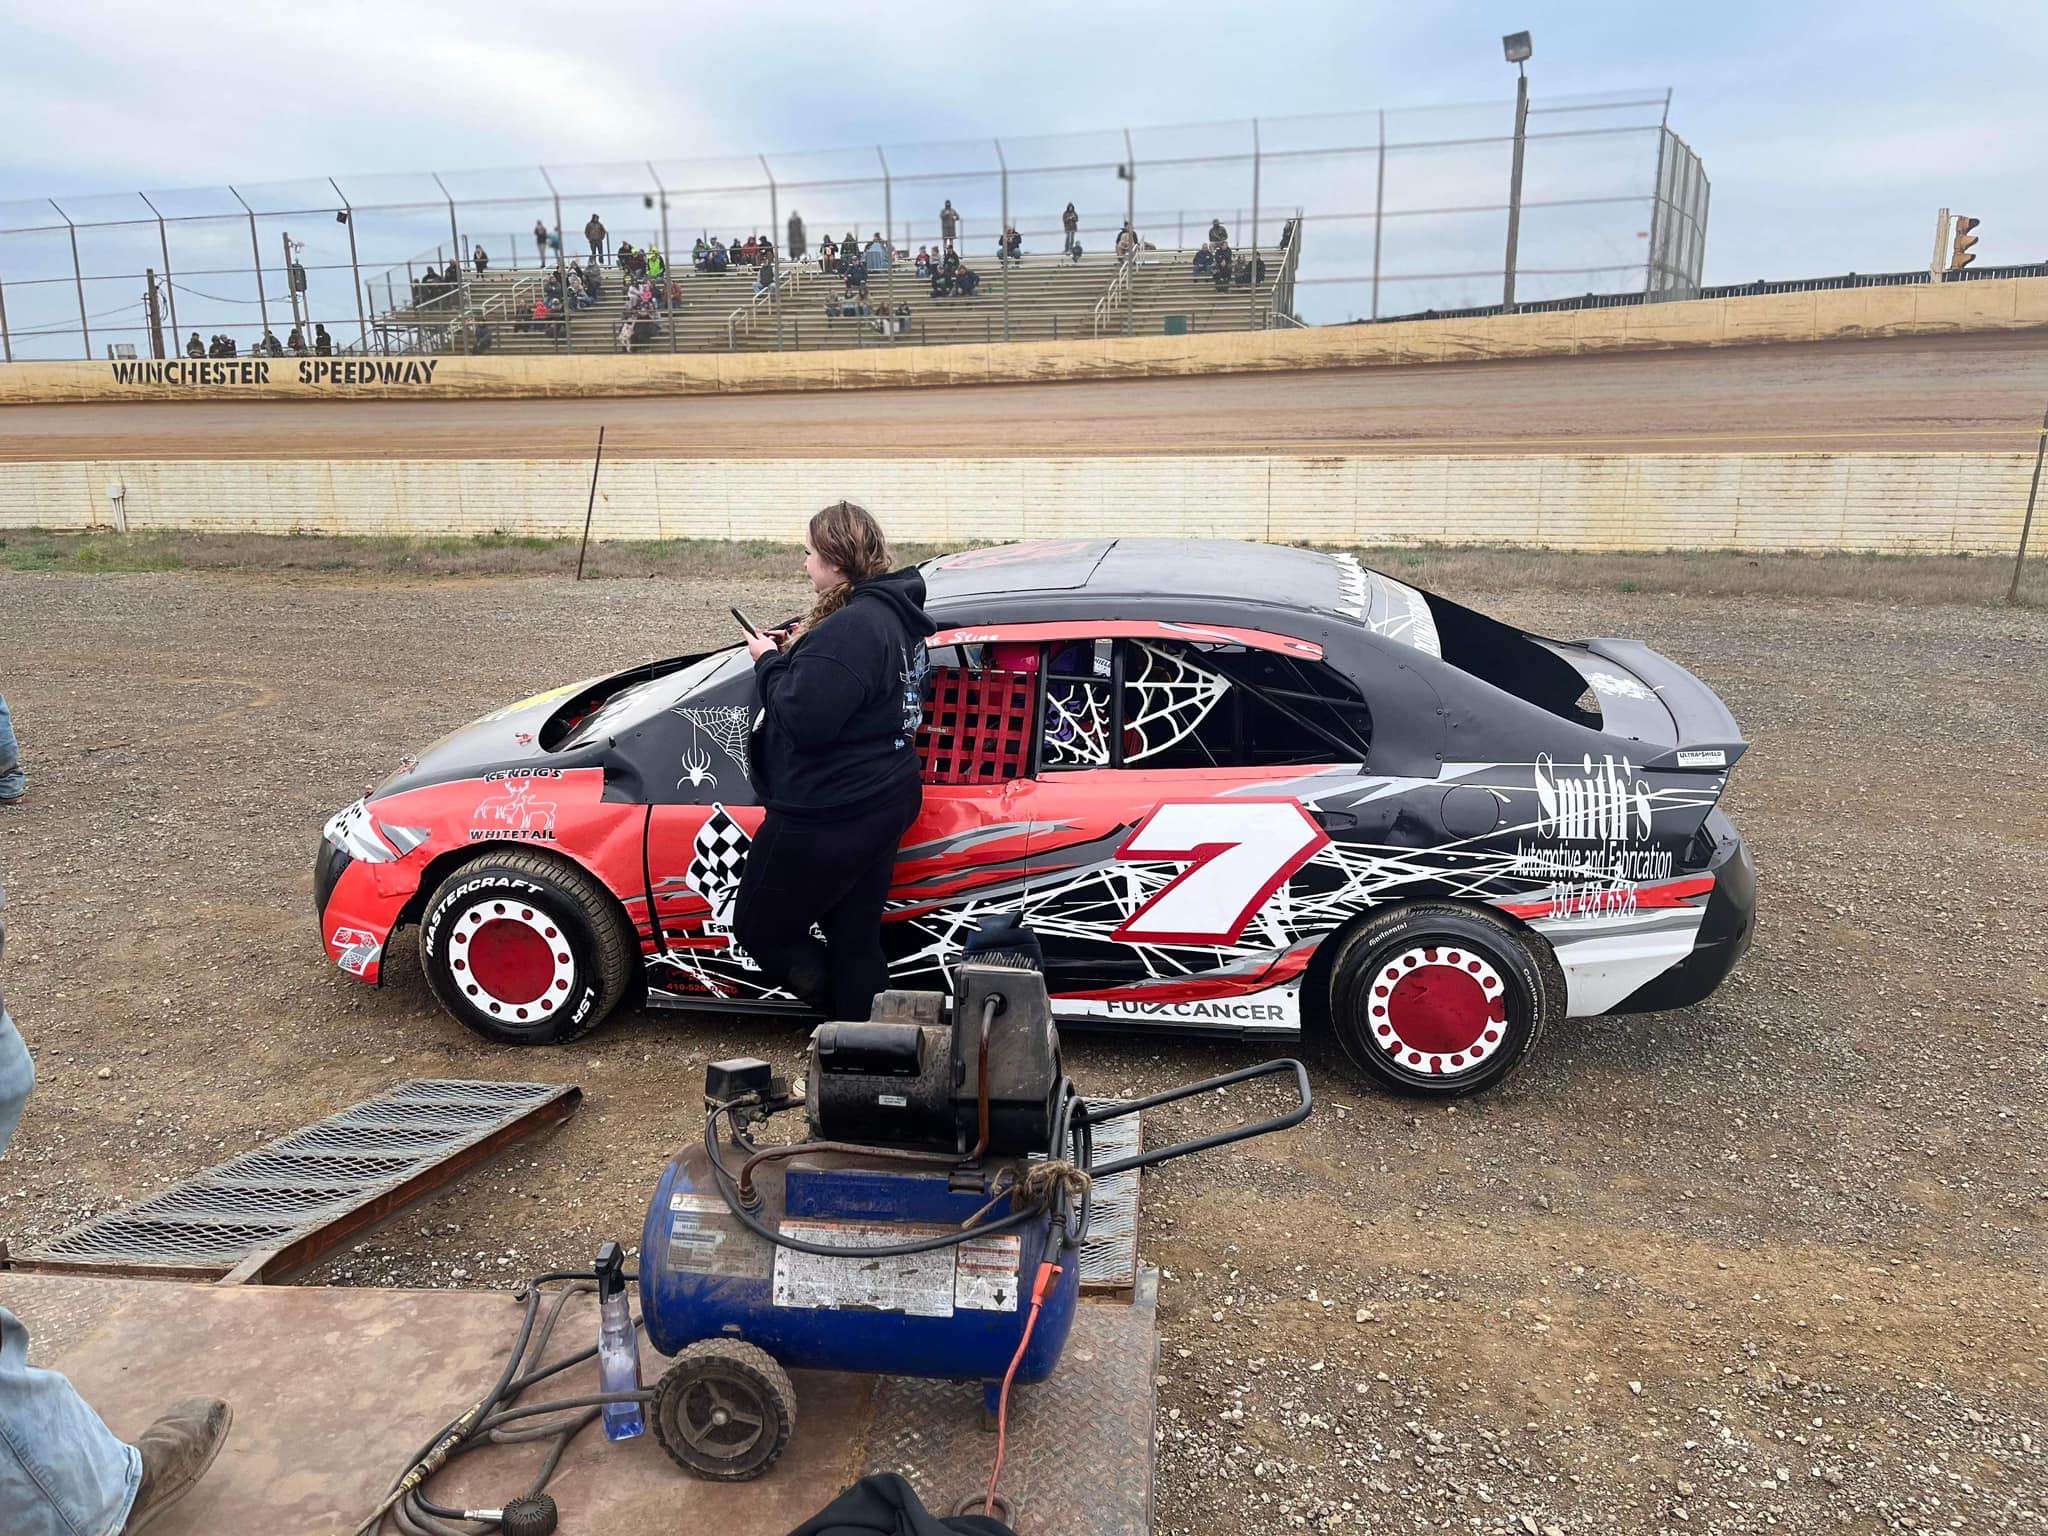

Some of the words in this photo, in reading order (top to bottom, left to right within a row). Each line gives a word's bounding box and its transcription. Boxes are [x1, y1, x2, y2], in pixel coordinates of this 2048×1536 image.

[112, 361, 270, 385] WINCHESTER
[298, 359, 438, 384] SPEEDWAY
[484, 767, 562, 783] KENDIG'S
[1534, 751, 1652, 842] Smith's
[470, 829, 557, 840] WHITETAIL
[1111, 797, 1331, 945] 7
[1513, 837, 1580, 879] Automotive
[1584, 840, 1606, 879] and
[1608, 841, 1673, 879] Fabrication
[426, 877, 544, 957] MASTERCRAFT
[1549, 880, 1574, 919] 330
[1578, 880, 1602, 919] 428
[571, 986, 595, 1024] LSR
[1174, 1003, 1284, 1020] CANCER
